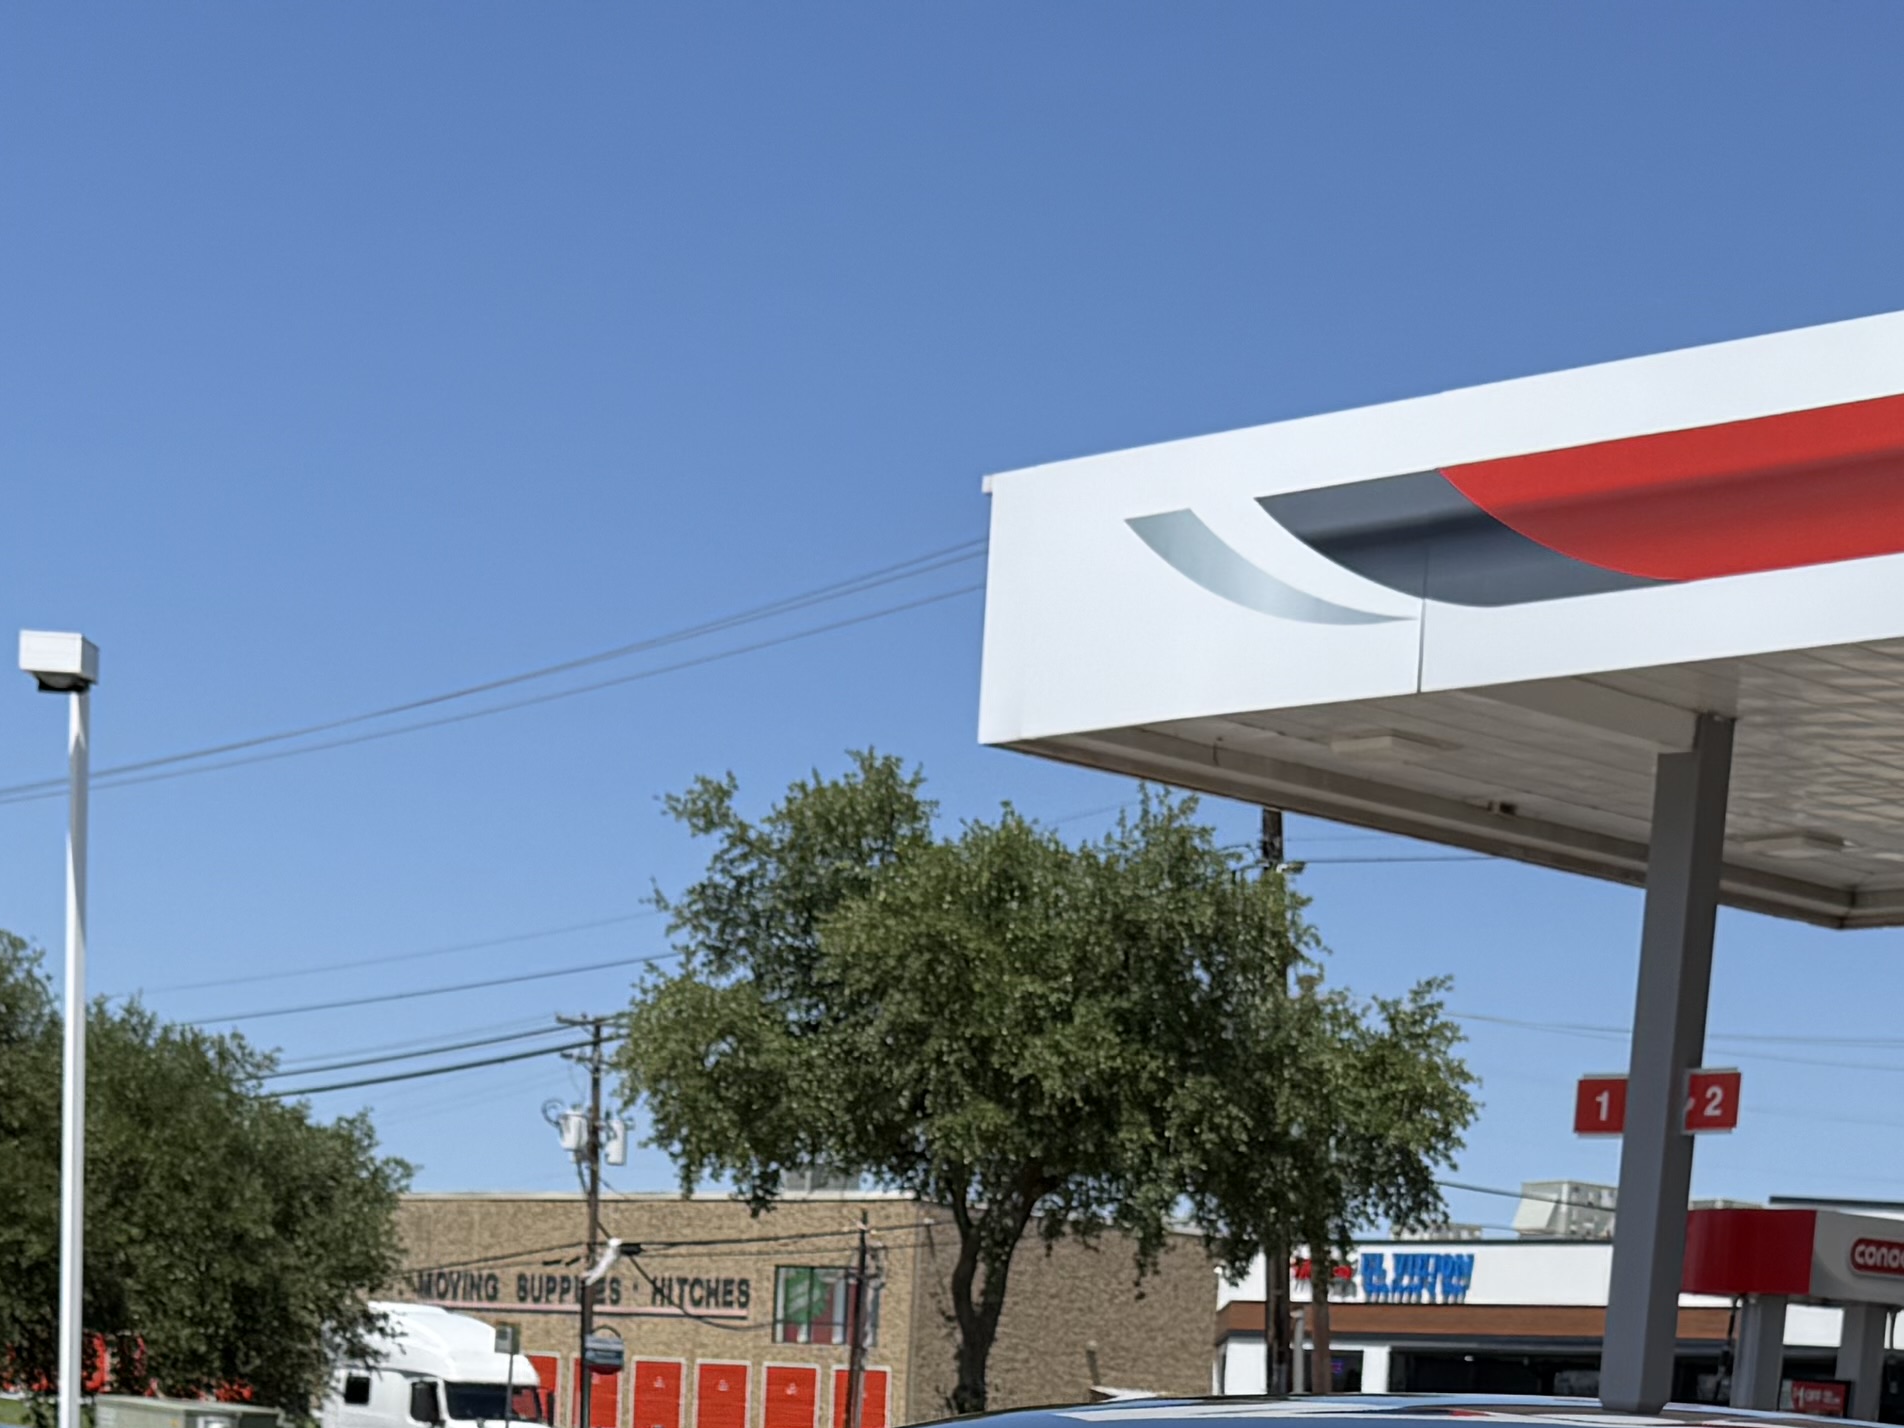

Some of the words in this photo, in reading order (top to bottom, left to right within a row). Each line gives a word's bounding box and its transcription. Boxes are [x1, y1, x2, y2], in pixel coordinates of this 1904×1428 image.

[1596, 1090, 1610, 1121] 1
[1703, 1085, 1724, 1116] 2
[418, 1271, 499, 1302] MOVING
[651, 1275, 752, 1309] HITCHES
